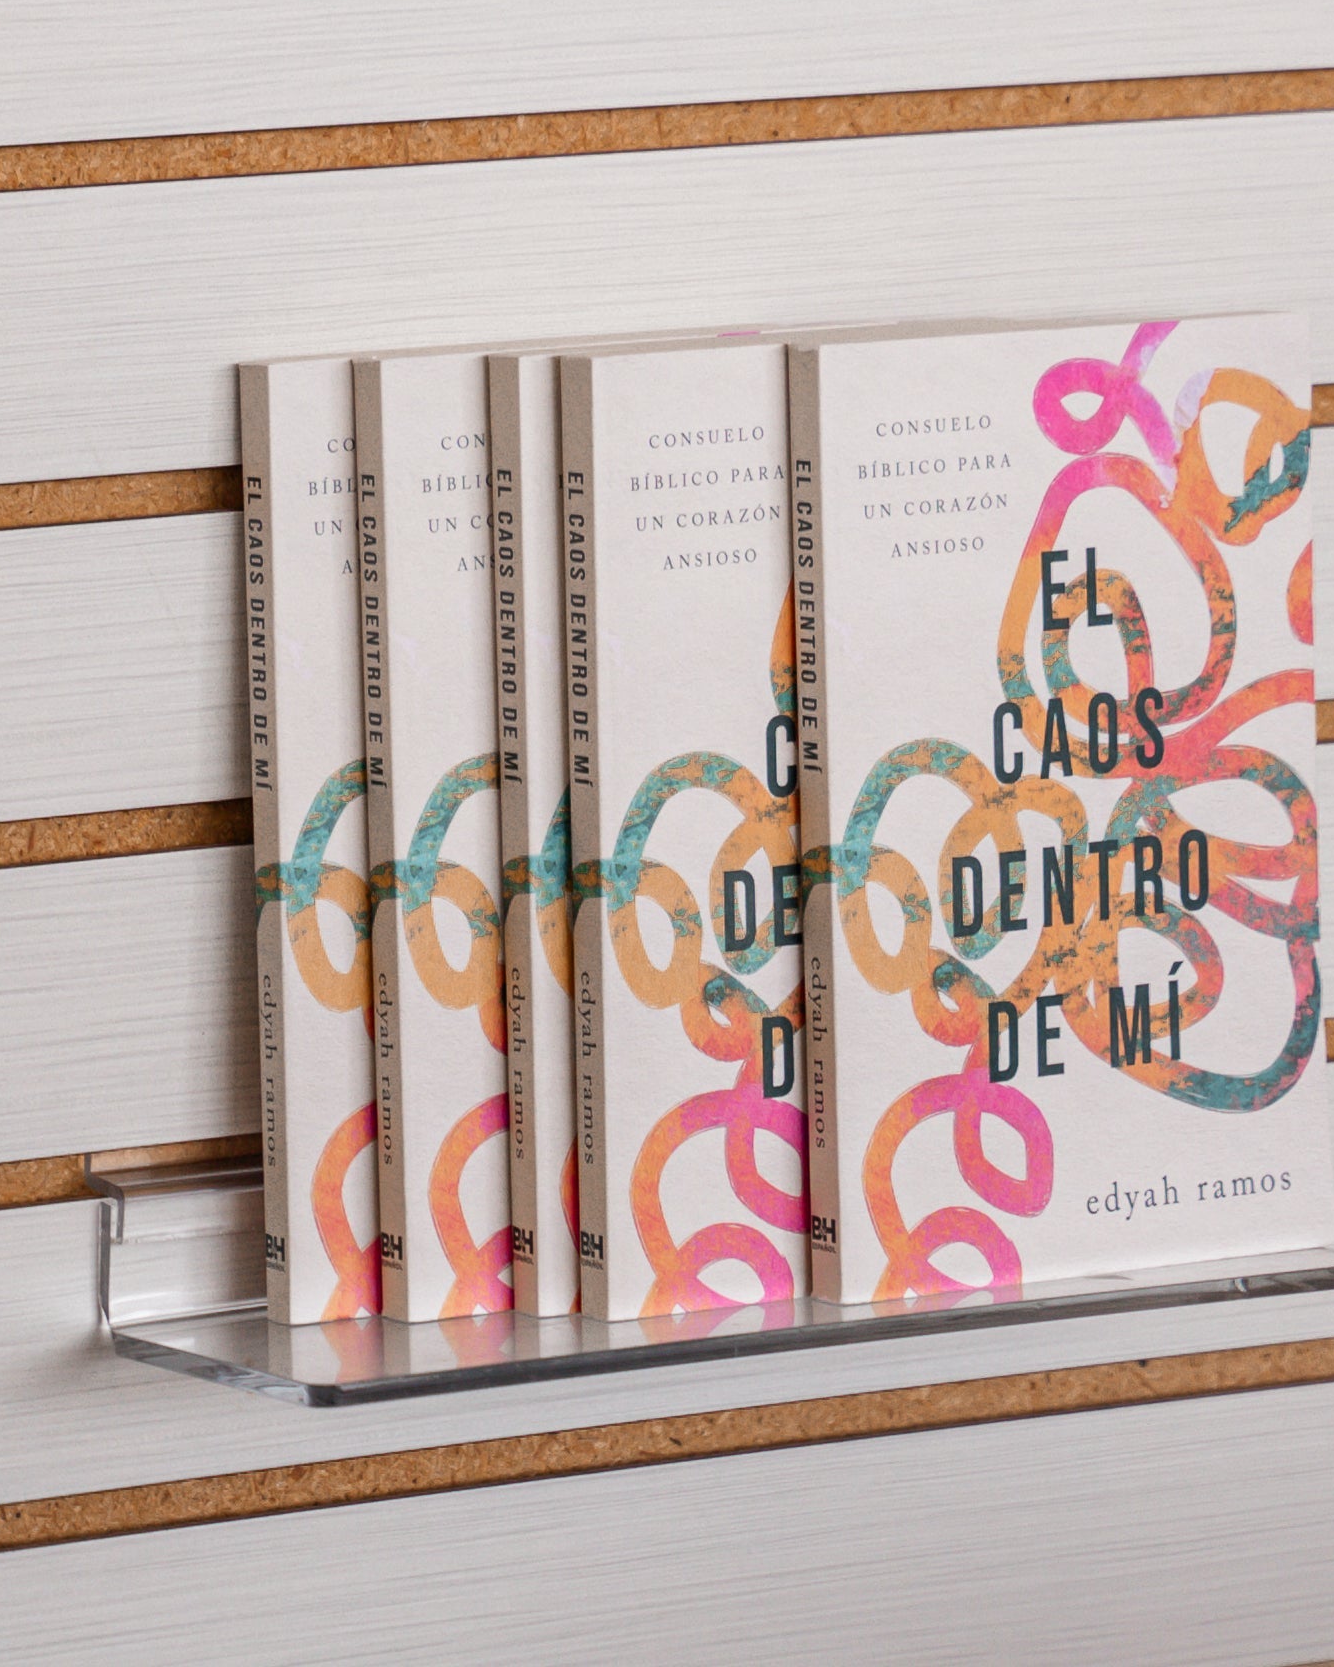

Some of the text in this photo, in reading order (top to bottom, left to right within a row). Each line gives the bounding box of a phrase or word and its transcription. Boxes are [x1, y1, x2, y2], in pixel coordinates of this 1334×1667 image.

[647, 426, 766, 450] CONSUELO
[857, 453, 1012, 481] BÍBLICO PARA
[875, 414, 993, 438] CONSUELO
[630, 465, 785, 493] BÍBLICO PARA
[636, 503, 782, 533] UN CORAZÓN
[864, 493, 1010, 521] UN CORAZÓN
[662, 548, 759, 571] ANSIOSO
[890, 535, 985, 558] ANSIOSO
[1040, 547, 1114, 632] EL
[247, 476, 273, 790] EL CAOS DENTRO DE MÍ
[360, 474, 387, 788] EL CAOS DENTRO DE MÍ
[497, 469, 522, 784] EL CAOS DENTRO DE MÍ
[568, 471, 592, 787] EL CAOS DENTRO DE MÍ
[796, 458, 822, 774] EL CAOS DENTRO DE MÍ
[993, 687, 1165, 785] CAOS
[951, 829, 1209, 938] DENTRO
[378, 972, 393, 1165] edyah ramos
[511, 967, 527, 1161] edyah ramos
[580, 970, 597, 1165] edyah ramos
[810, 956, 828, 1150] edyah ramos
[988, 962, 1184, 1084] DE MÍ
[1086, 1171, 1293, 1221] edyah ramos
